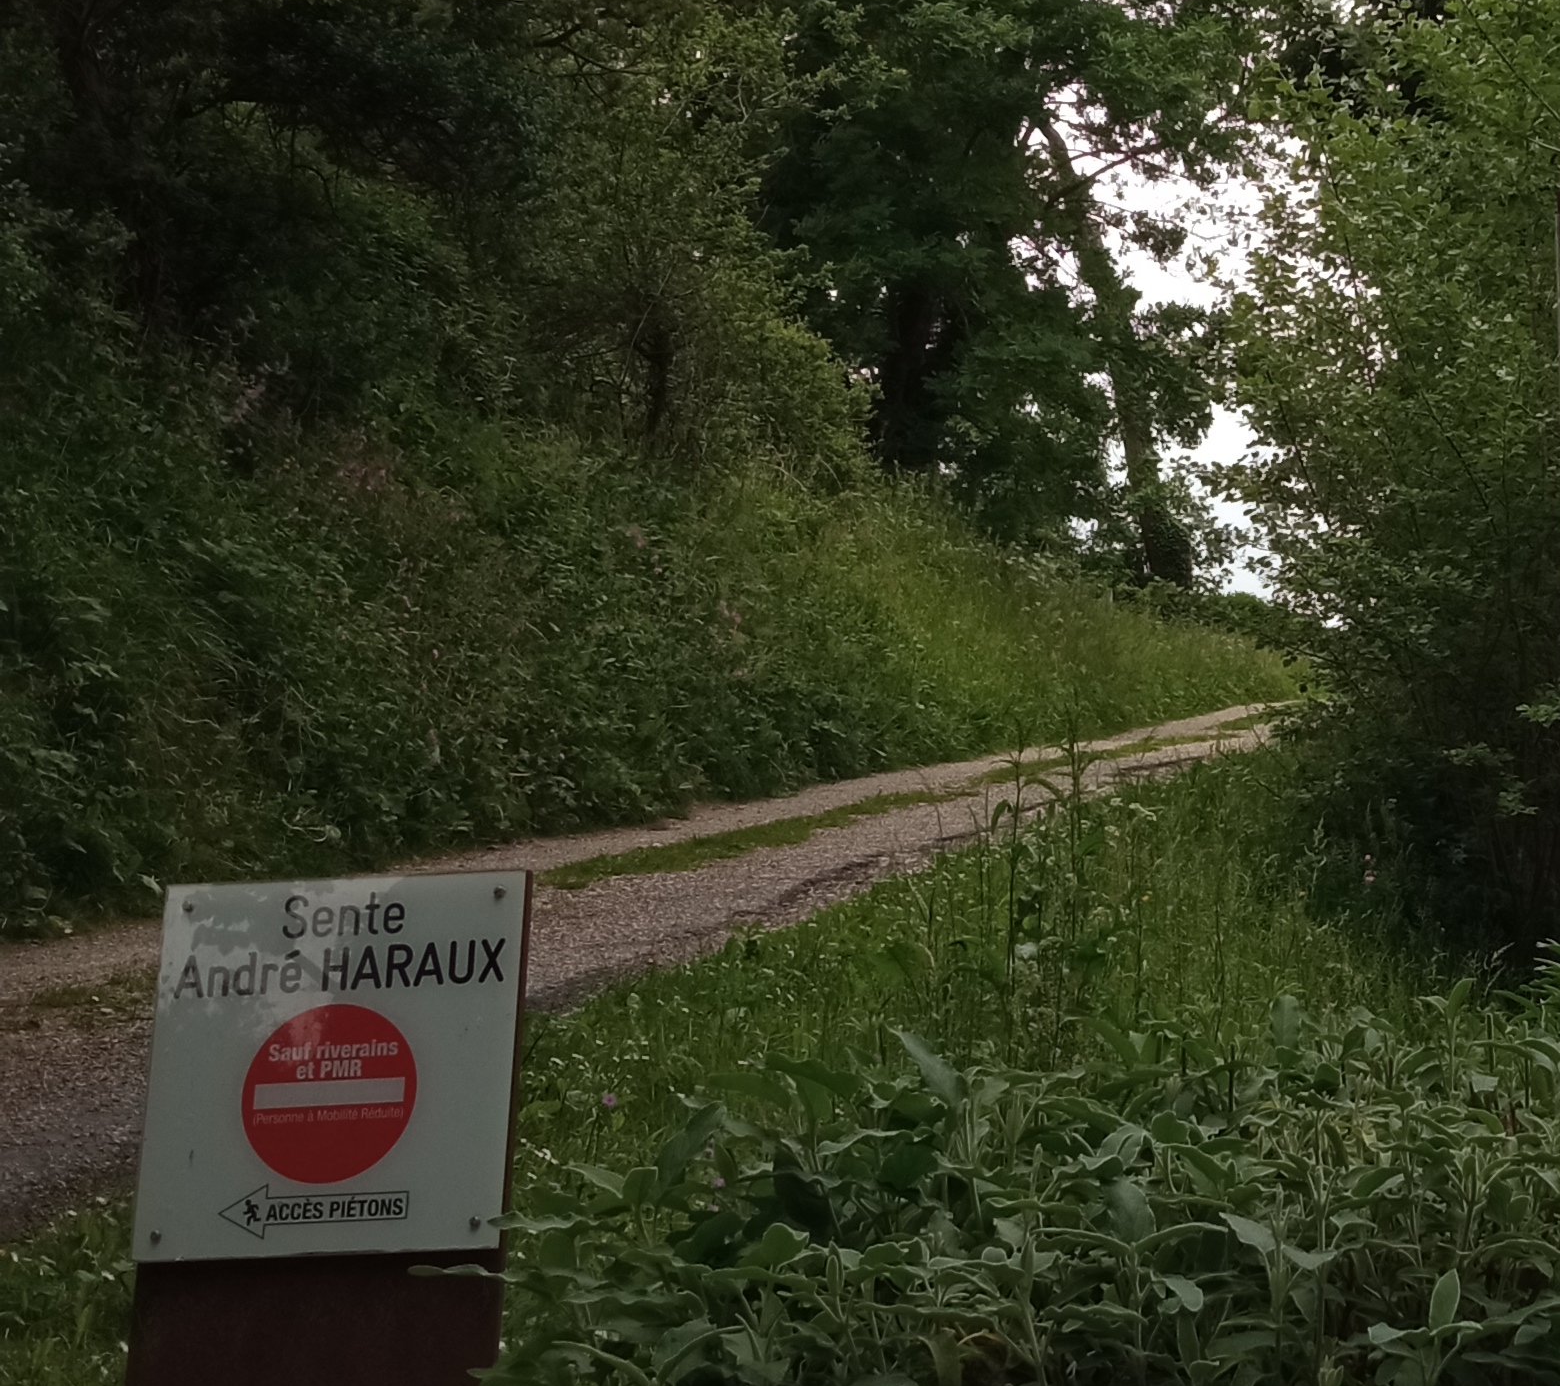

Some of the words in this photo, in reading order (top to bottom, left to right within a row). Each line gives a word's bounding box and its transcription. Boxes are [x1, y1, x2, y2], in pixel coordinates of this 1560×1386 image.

[282, 891, 406, 940] Sente
[173, 950, 302, 1000] André
[321, 937, 507, 993] HARAUX
[268, 1041, 312, 1062] Sauf
[316, 1039, 399, 1060] riverains
[296, 1062, 315, 1080] et
[320, 1059, 362, 1079] PMR
[265, 1198, 325, 1222] ACCÈS
[328, 1196, 404, 1219] PIÉTONS
